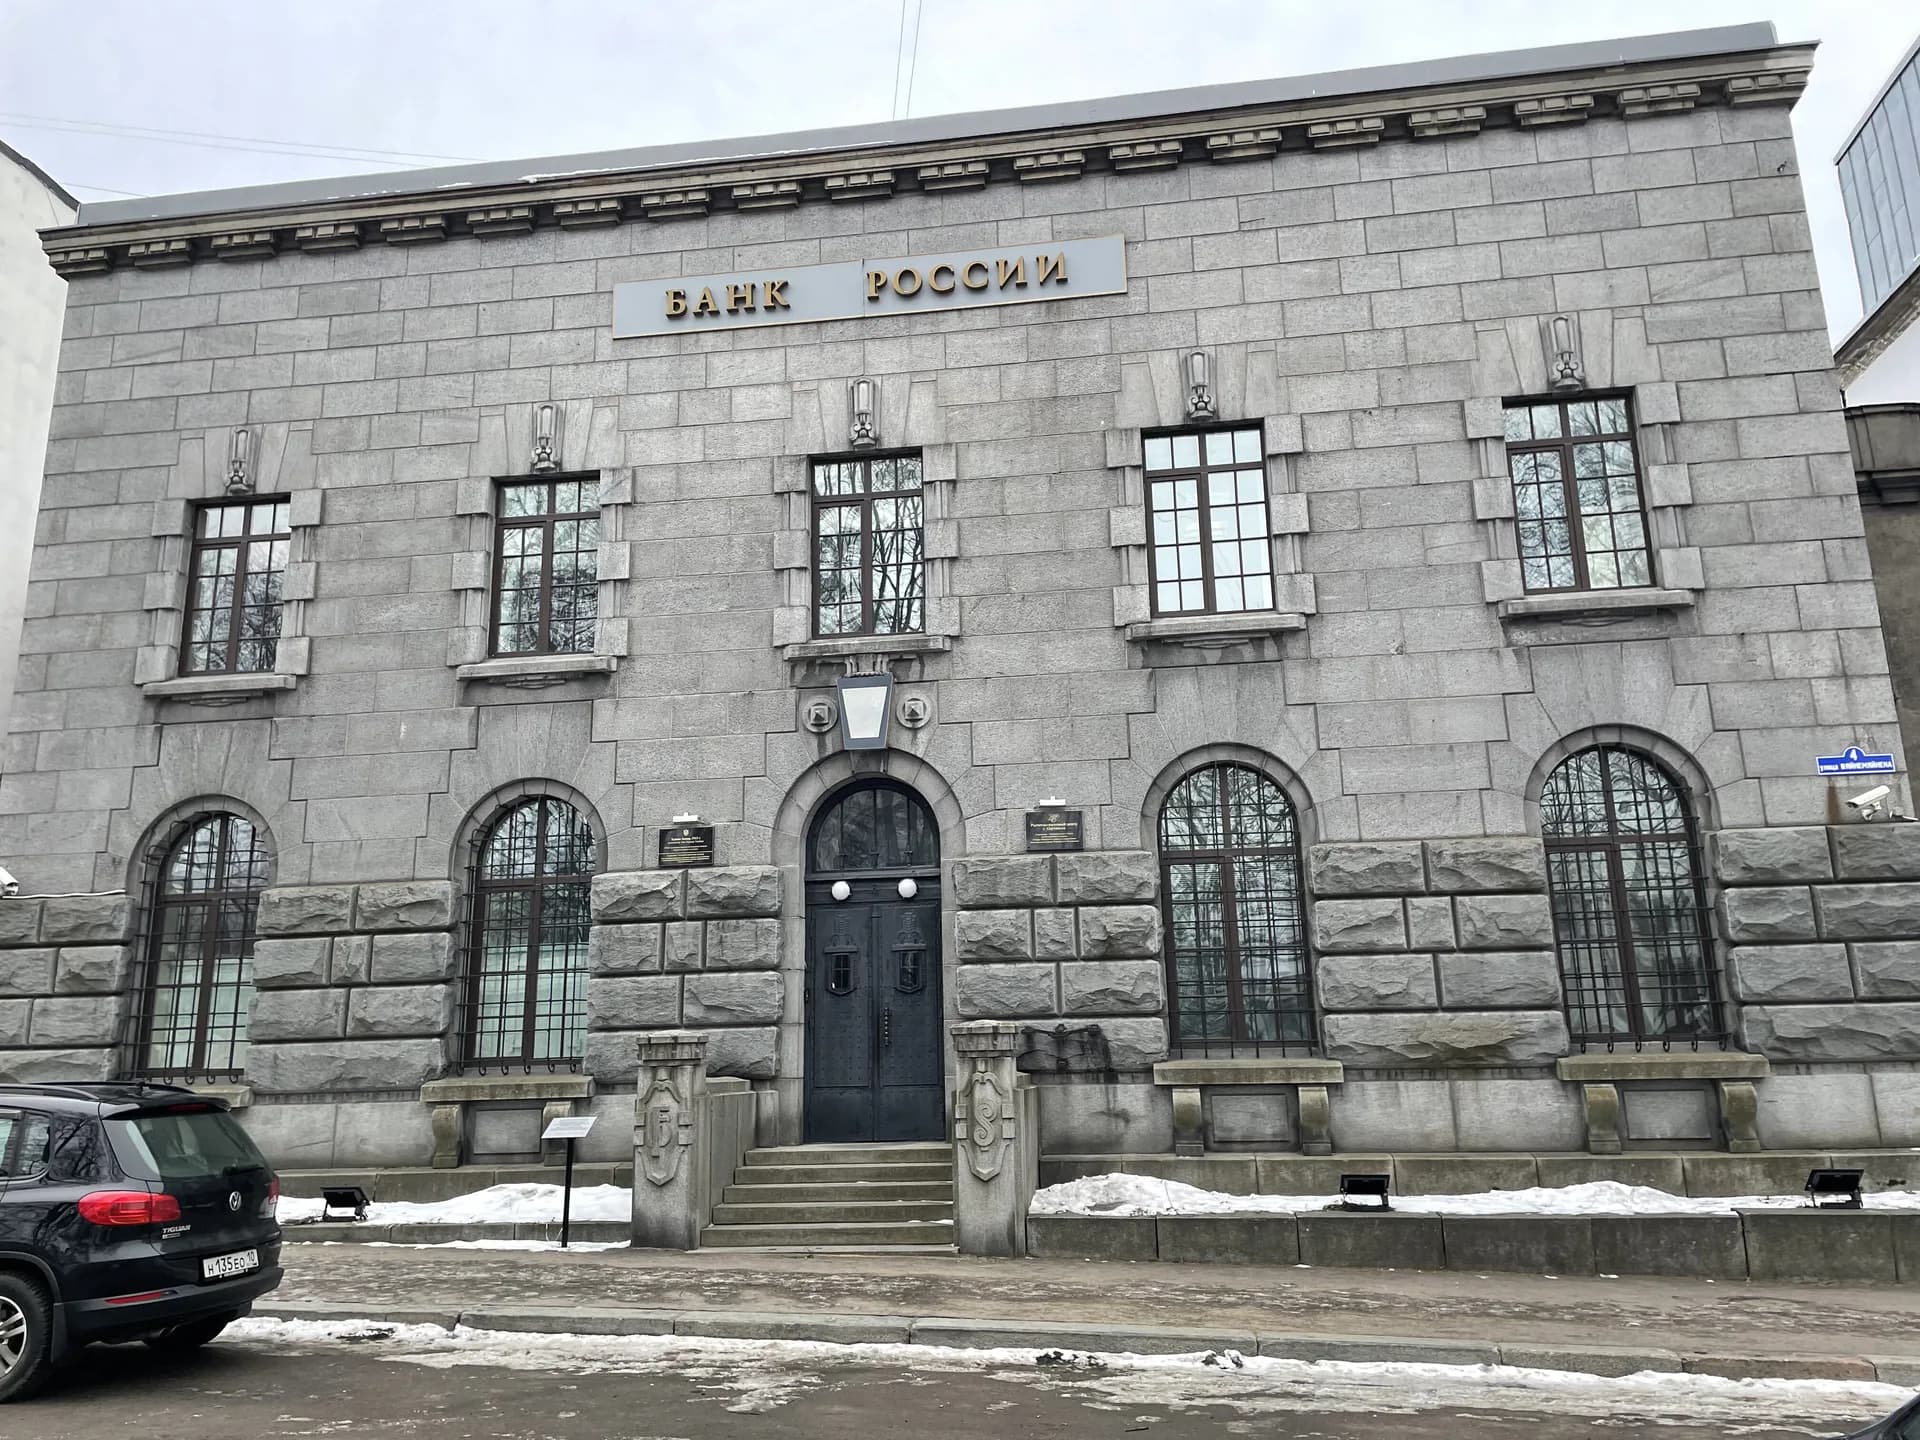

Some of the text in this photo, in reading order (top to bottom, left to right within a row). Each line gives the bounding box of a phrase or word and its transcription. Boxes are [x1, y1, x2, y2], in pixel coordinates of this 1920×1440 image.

[665, 251, 1069, 320] БАНК РОССИИ
[1850, 748, 1858, 761] 4
